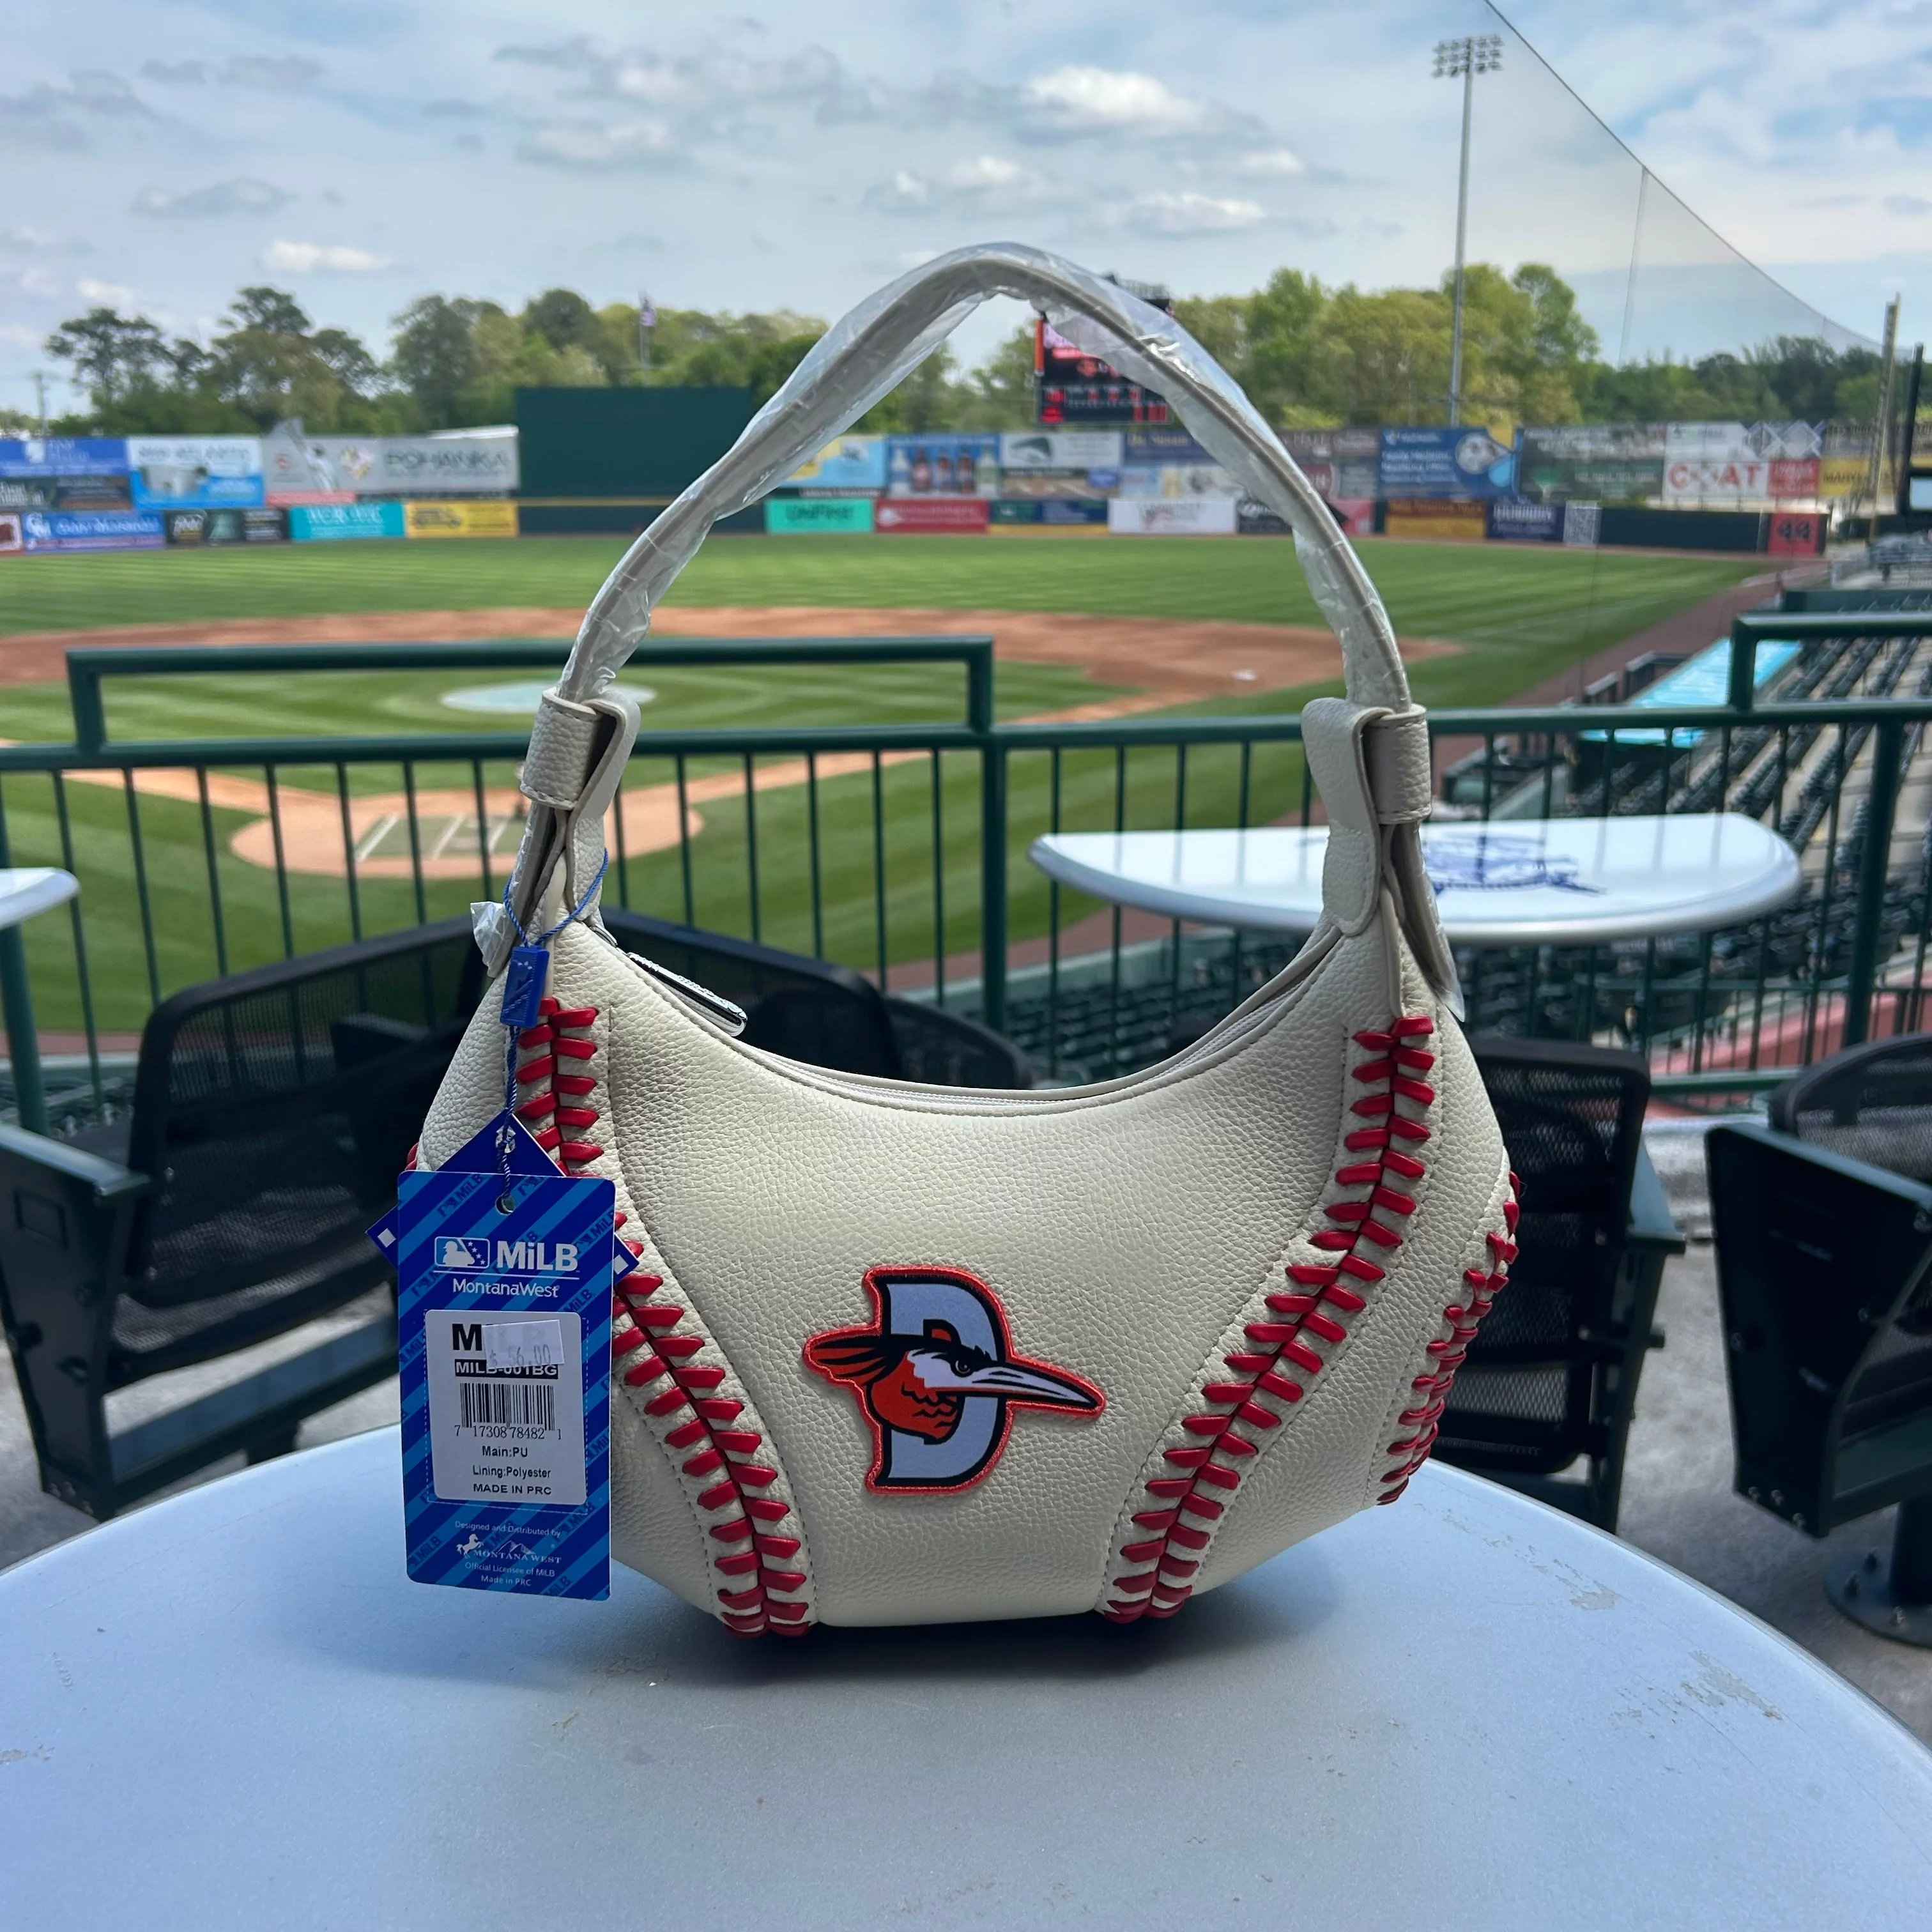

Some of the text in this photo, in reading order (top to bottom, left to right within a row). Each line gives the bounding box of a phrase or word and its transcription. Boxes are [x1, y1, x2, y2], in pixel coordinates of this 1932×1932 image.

[497, 1240, 578, 1271] MiLB
[452, 1278, 560, 1298] MontanaWest
[454, 1425, 562, 1440] 7 17308 78482 1
[482, 1445, 528, 1458] Main:PU
[472, 1464, 551, 1479] Lining:Polyester
[473, 1483, 552, 1496] MADE IN PRC
[454, 1521, 562, 1538] Designed and Distributed by
[473, 1549, 562, 1564] MONTANA WEST
[464, 1561, 556, 1577] Official Licensee of MiLB
[480, 1574, 532, 1586] Made in PRC
